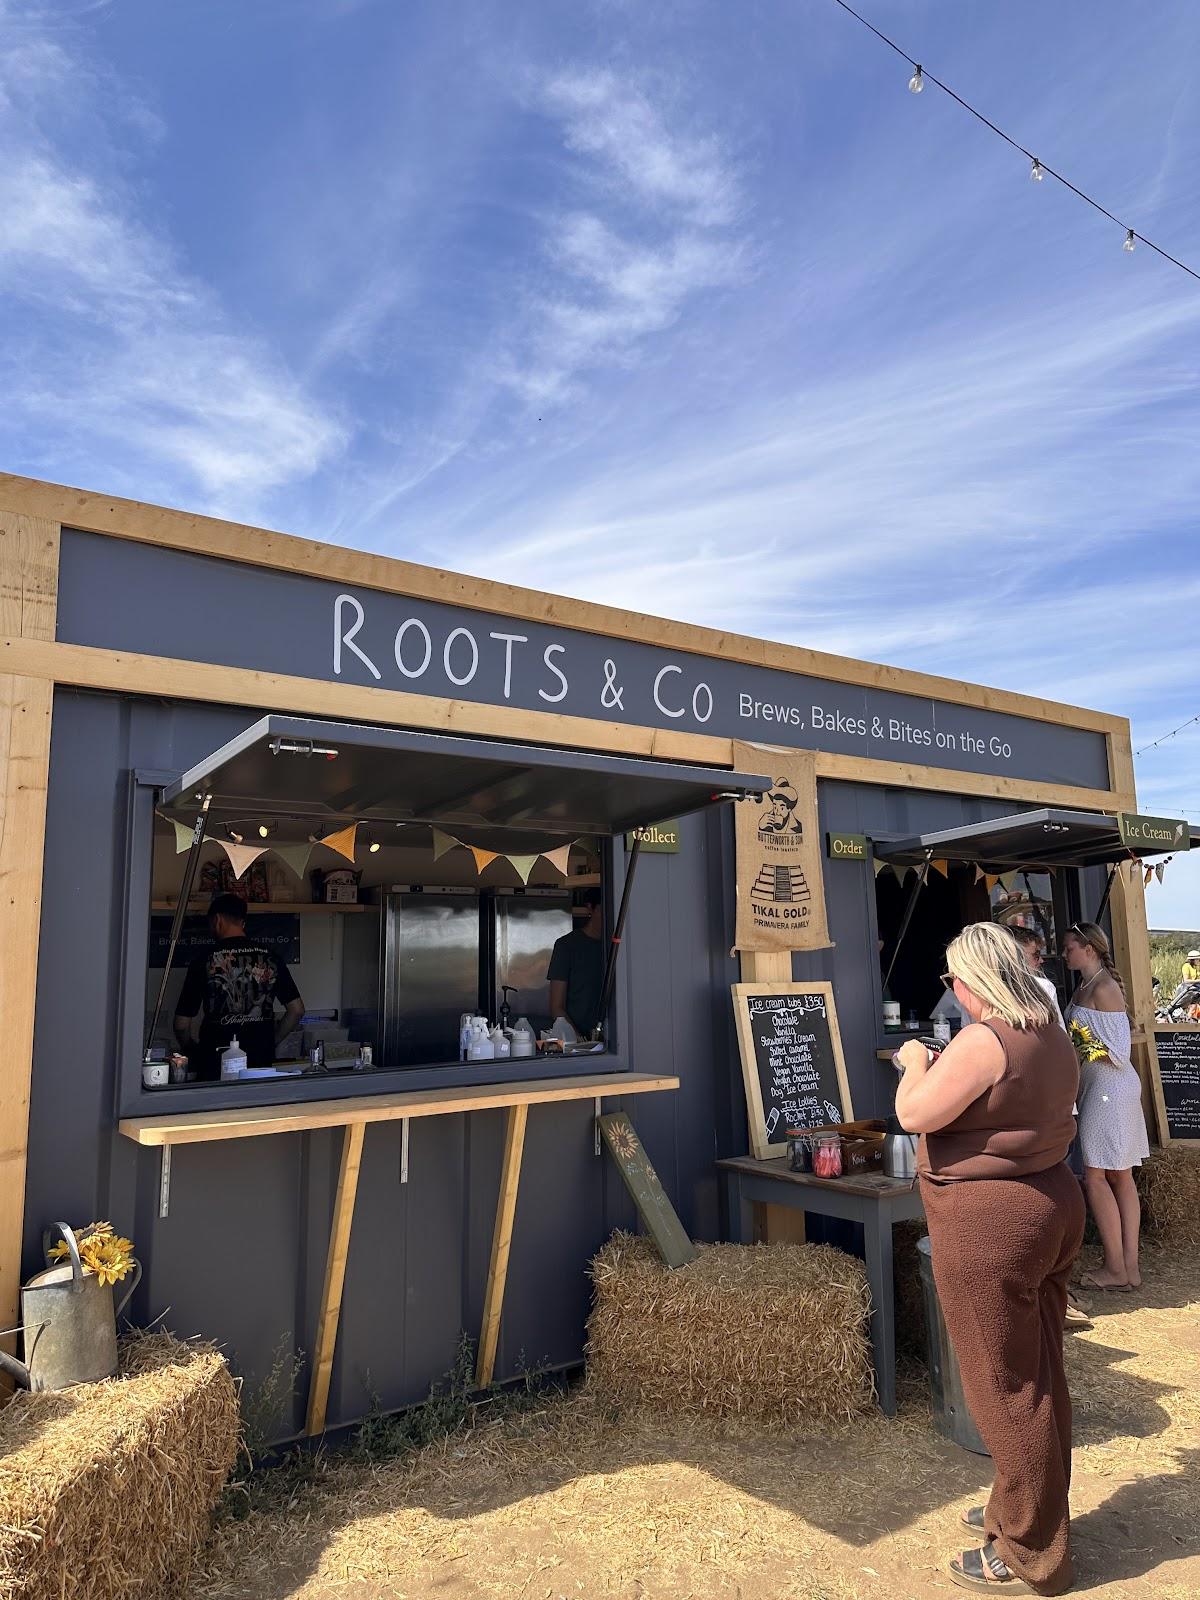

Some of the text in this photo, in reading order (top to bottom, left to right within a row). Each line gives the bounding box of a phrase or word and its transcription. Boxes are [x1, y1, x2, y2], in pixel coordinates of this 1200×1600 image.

[333, 593, 713, 722] ROOTS & Co
[739, 693, 1012, 758] Brews, Bakes & Bites on the Go
[1125, 820, 1173, 841] Ice Cream
[757, 831, 790, 846] BUTTERWORTH
[833, 839, 863, 855] Order
[751, 903, 807, 919] TIKAL GOLD
[753, 918, 810, 930] PRIMAVERA FAMILY
[276, 935, 290, 944] Go
[748, 997, 764, 1011] Ice
[765, 998, 786, 1010] cream
[787, 996, 802, 1008] tubs
[771, 1012, 800, 1026] Chocolate
[774, 1026, 797, 1036] Vanilla
[769, 1045, 787, 1057] Salted
[784, 1054, 813, 1065] Chocolate
[773, 1062, 816, 1077] Vegan Vanilla
[772, 1071, 821, 1090] Vegan Chocolate
[770, 1082, 820, 1099] Dog Ice Cream
[781, 1095, 818, 1110] Ice Lollies
[784, 1110, 807, 1124] Rocket
